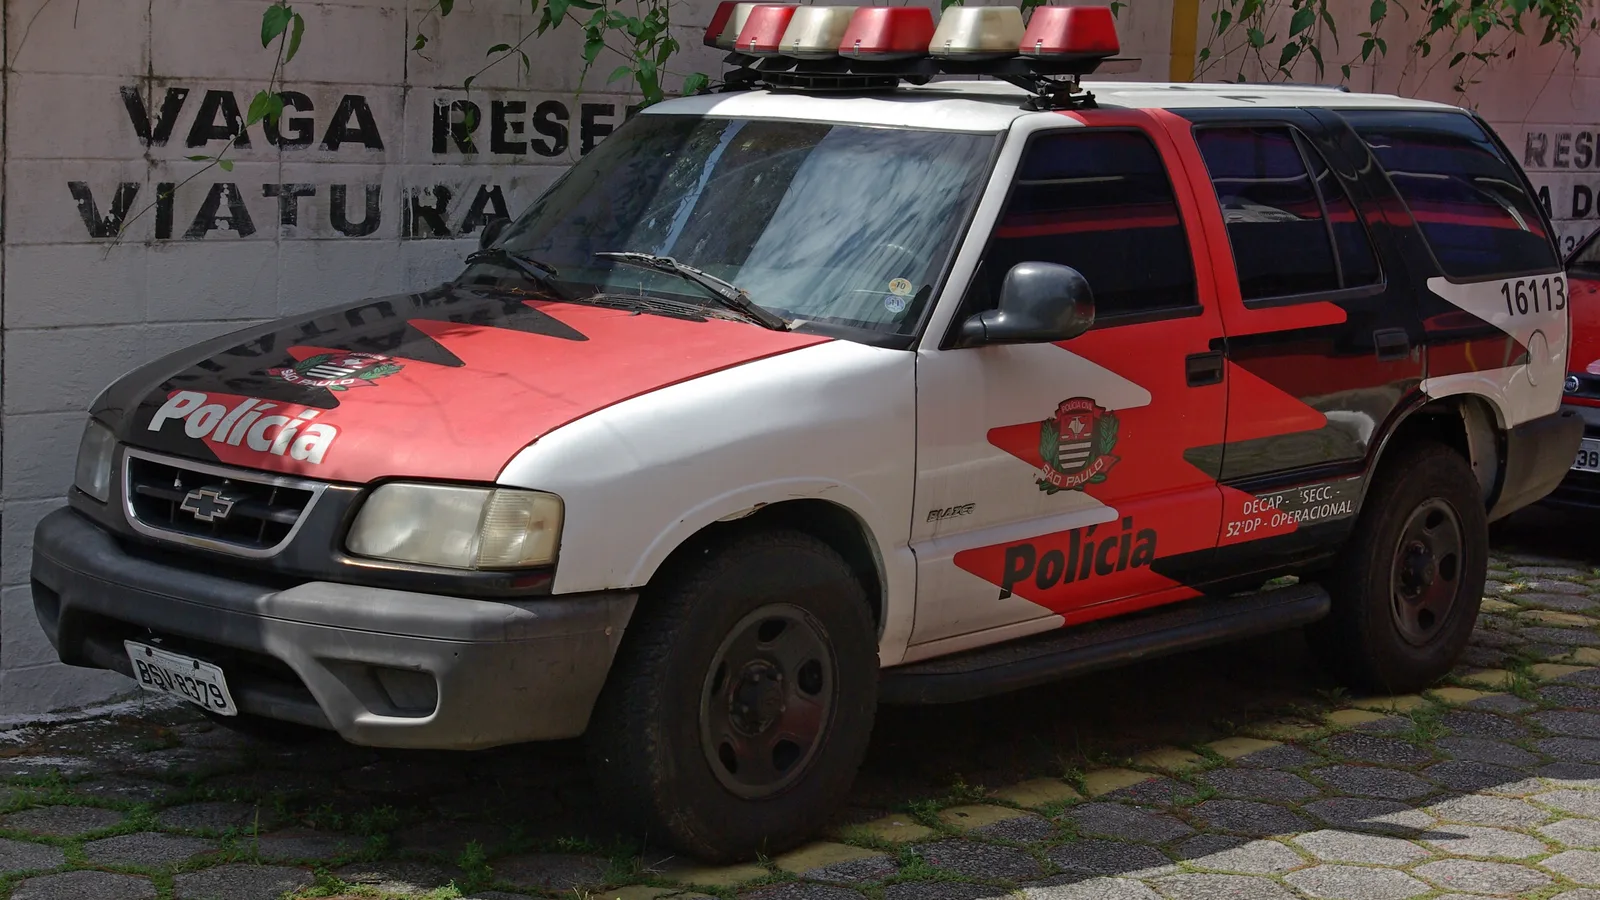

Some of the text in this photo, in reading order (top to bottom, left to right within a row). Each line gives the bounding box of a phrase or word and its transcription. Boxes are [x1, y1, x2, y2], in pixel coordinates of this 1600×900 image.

[119, 85, 641, 157] VAGA RESE
[1572, 184, 1600, 218] D
[1501, 276, 1566, 316] 16113
[298, 378, 355, 387] PAULO
[147, 390, 338, 464] Polícia
[1042, 458, 1104, 487] SÃO PAULO
[1243, 495, 1283, 515] DECAP
[1271, 500, 1352, 528] OPERACIONAL
[998, 516, 1158, 601] Polícia
